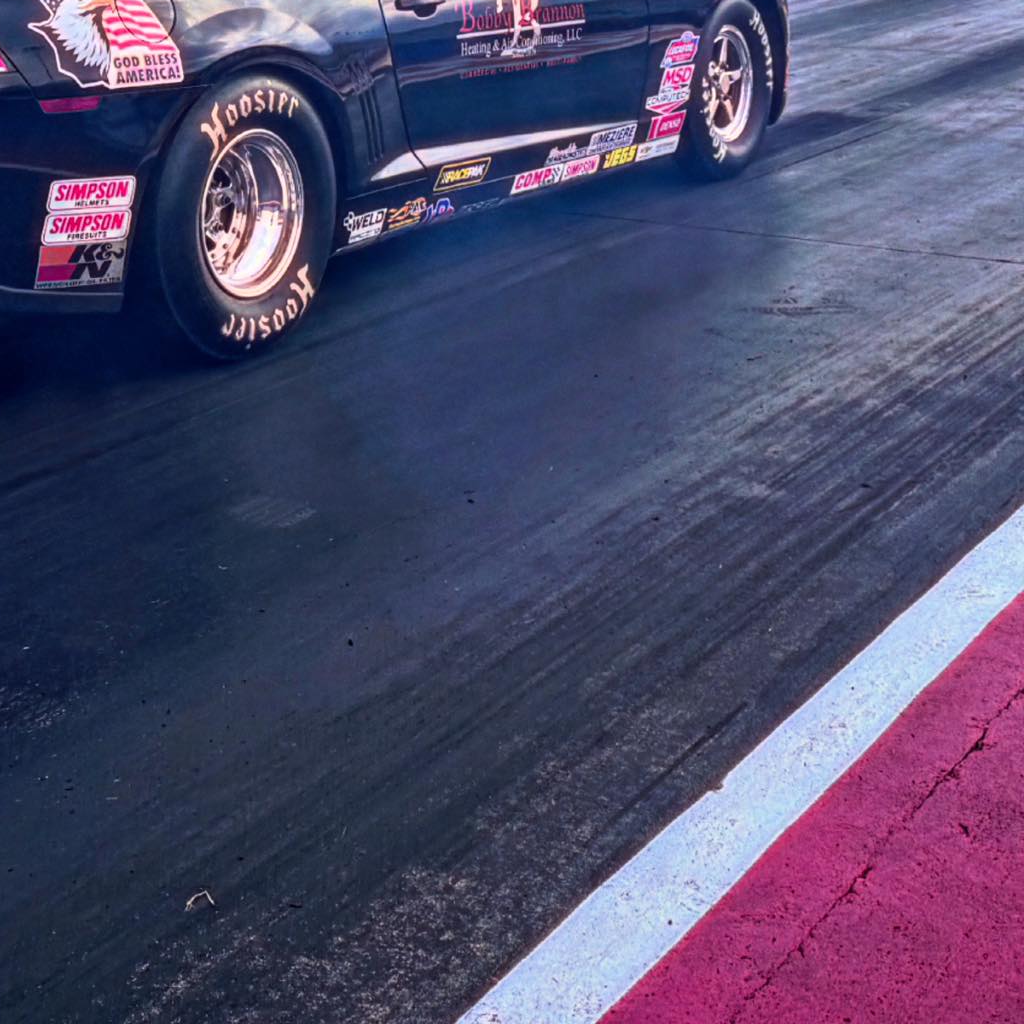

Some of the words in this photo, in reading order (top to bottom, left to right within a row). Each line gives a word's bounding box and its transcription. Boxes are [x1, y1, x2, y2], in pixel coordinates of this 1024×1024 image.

[455, 0, 513, 36] Bobby
[460, 42, 492, 58] Heating
[492, 40, 500, 51] &
[566, 28, 583, 42] LLC
[113, 57, 140, 69] GOD
[144, 53, 177, 66] BLESS
[116, 66, 181, 84] AMERICA!
[662, 66, 692, 86] MSD
[201, 88, 300, 161] Hoosier
[514, 166, 553, 190] COMP
[565, 159, 598, 177] SIMPSON
[54, 181, 129, 201] SIMPSON
[75, 199, 109, 207] HELMETS
[50, 213, 125, 234] SIMPSON
[351, 210, 386, 231] WELD
[67, 231, 107, 240] FIRESUITS
[221, 263, 316, 341] Hoosier
